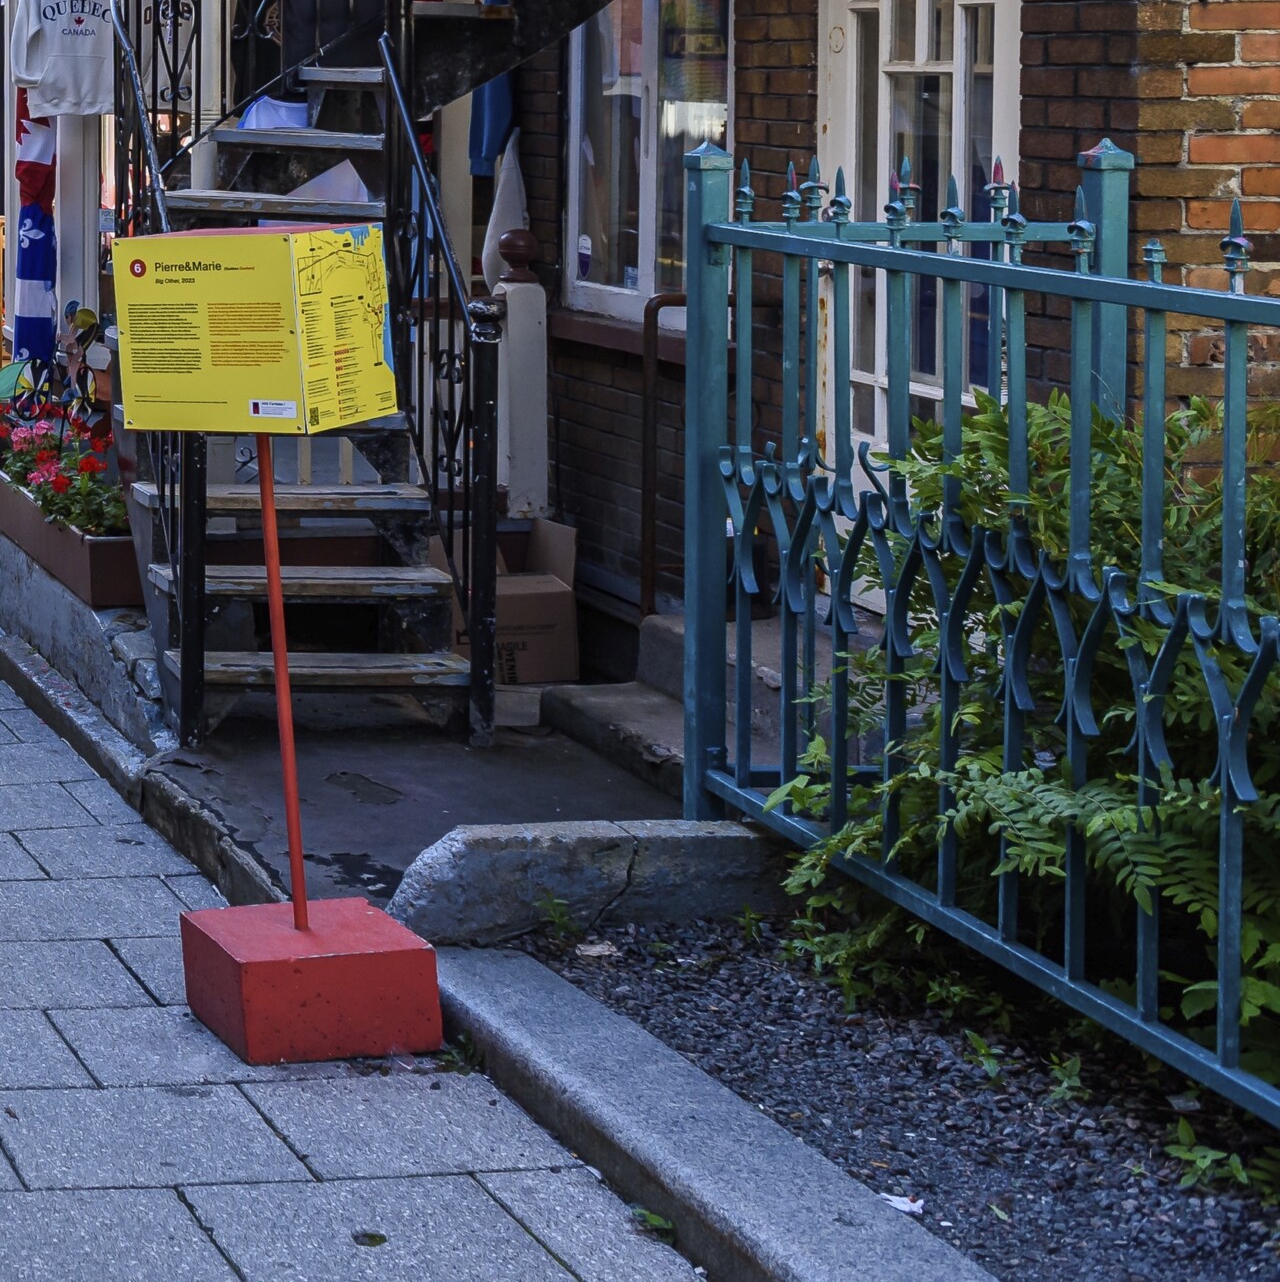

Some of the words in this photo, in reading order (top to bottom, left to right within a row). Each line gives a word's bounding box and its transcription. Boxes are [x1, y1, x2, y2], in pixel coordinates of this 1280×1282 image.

[61, 28, 96, 36] CANADA
[133, 263, 142, 274] 6
[154, 261, 222, 272] Pierre&Marie
